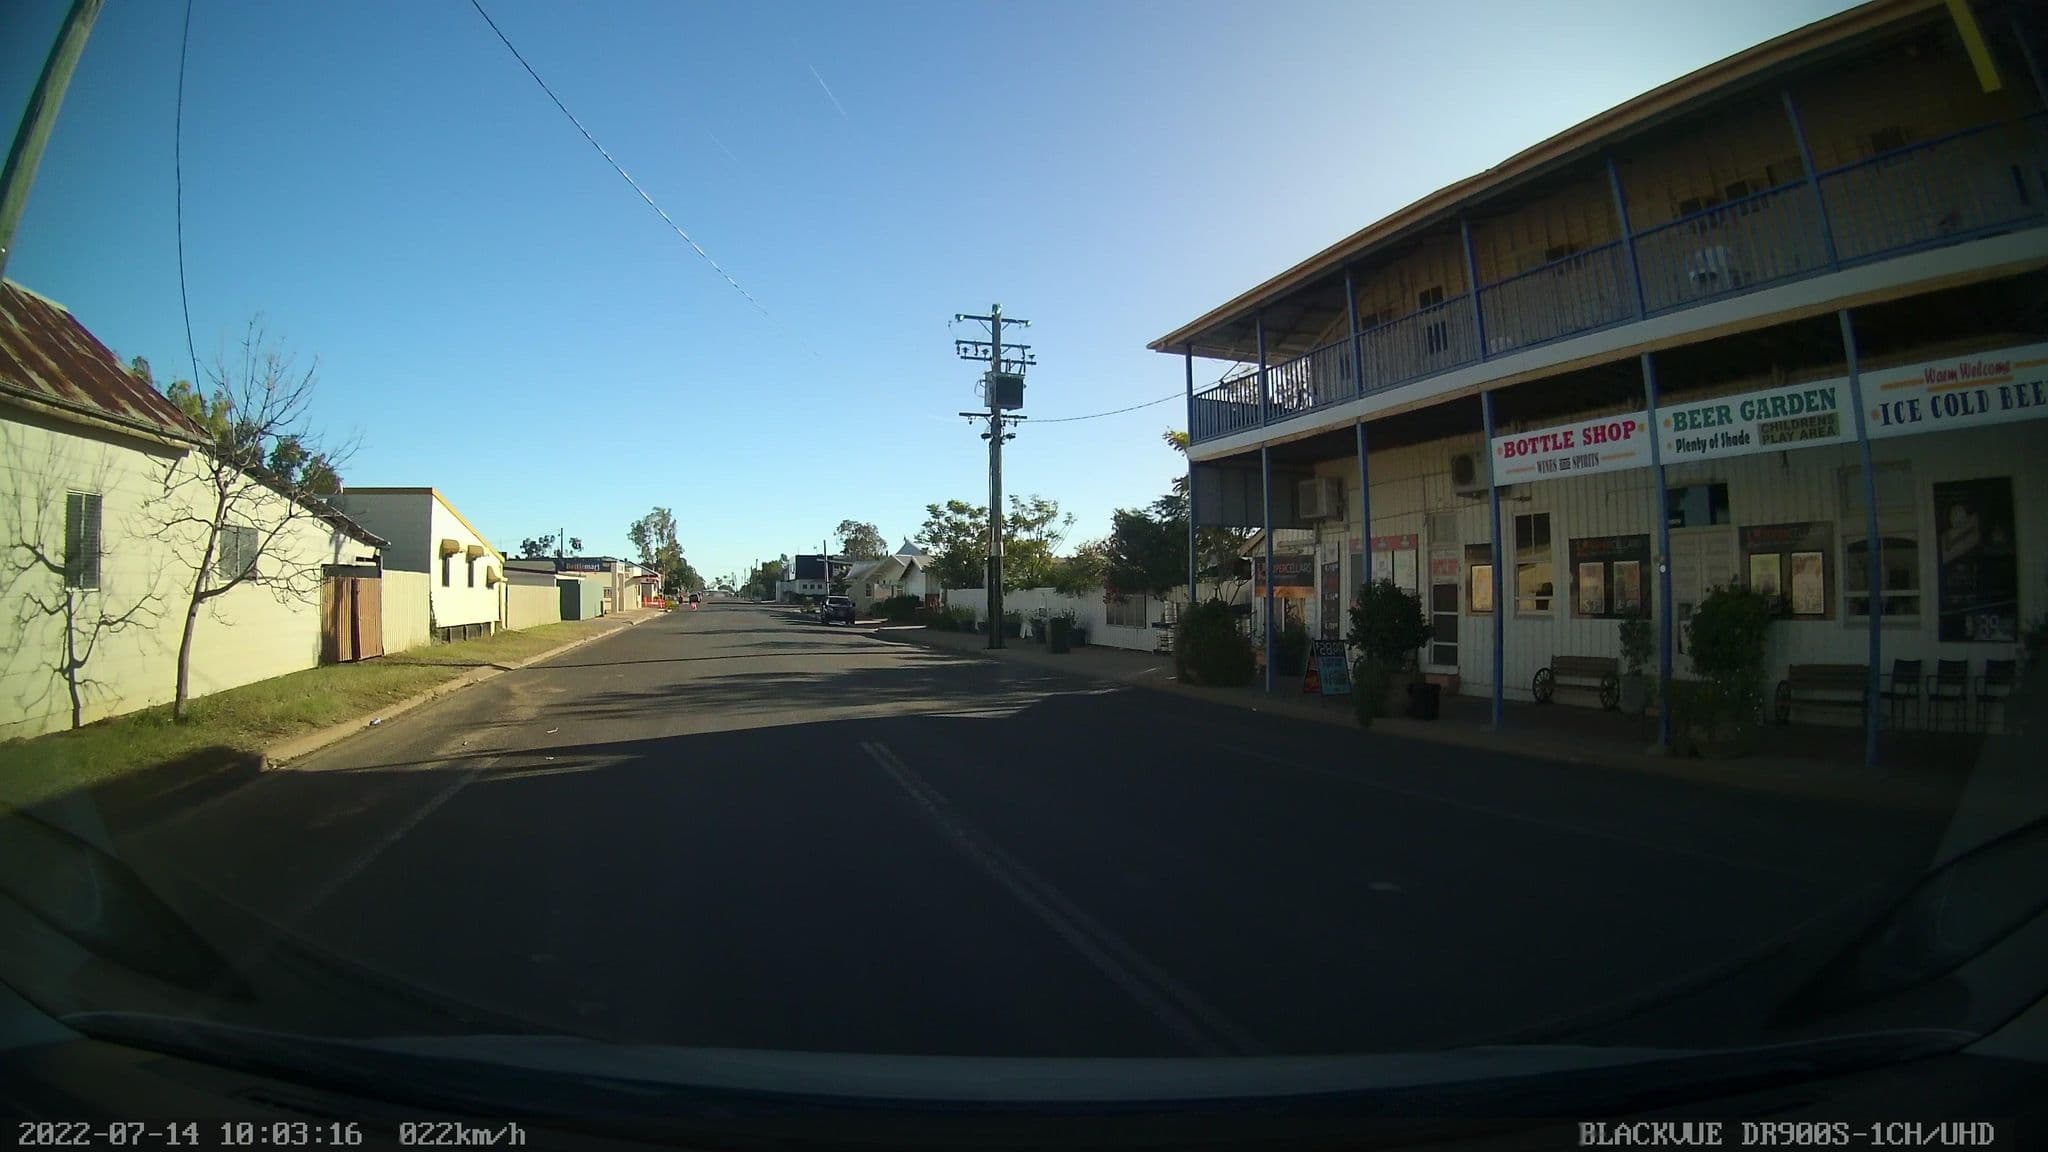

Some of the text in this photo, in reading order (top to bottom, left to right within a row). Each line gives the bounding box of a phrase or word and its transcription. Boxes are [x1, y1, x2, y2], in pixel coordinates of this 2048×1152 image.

[1924, 360, 2011, 384] Warm Welcome
[1672, 387, 1836, 433] BEER GARDEN
[1880, 380, 2048, 426] ICE COLD BEE
[1761, 414, 1835, 434] CHILDRENS
[1762, 426, 1836, 446] PLAY AREA
[1504, 420, 1636, 459] BOTTLE SHOP
[1675, 430, 1751, 454] Plenty of Shade
[1536, 457, 1558, 475] WINES
[1572, 452, 1600, 470] SPIRITS
